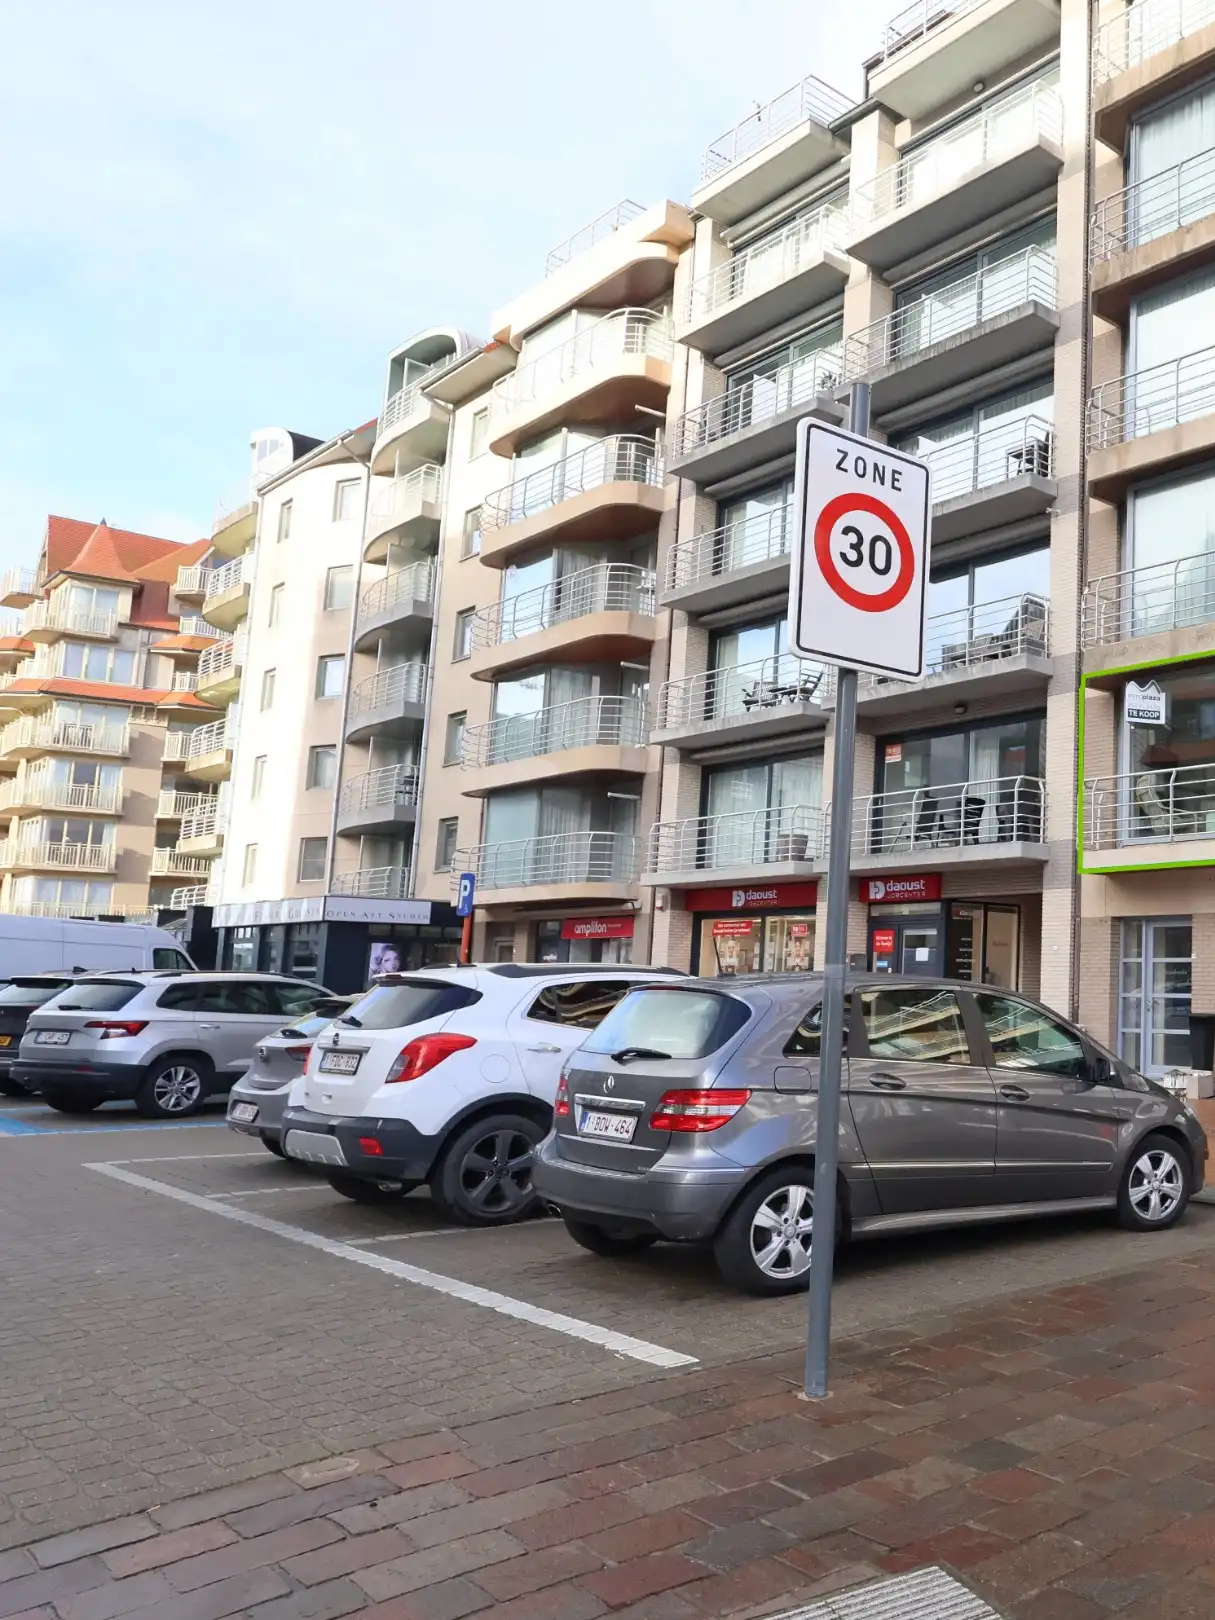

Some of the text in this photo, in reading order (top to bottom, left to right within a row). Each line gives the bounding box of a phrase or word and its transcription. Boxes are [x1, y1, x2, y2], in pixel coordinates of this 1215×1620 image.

[835, 448, 903, 492] ZONE
[839, 525, 893, 576] 30
[1129, 709, 1160, 719] TE KOOP
[459, 879, 471, 909] P
[886, 879, 926, 892] daoust
[746, 889, 778, 900] daoust
[574, 920, 607, 937] amplifon
